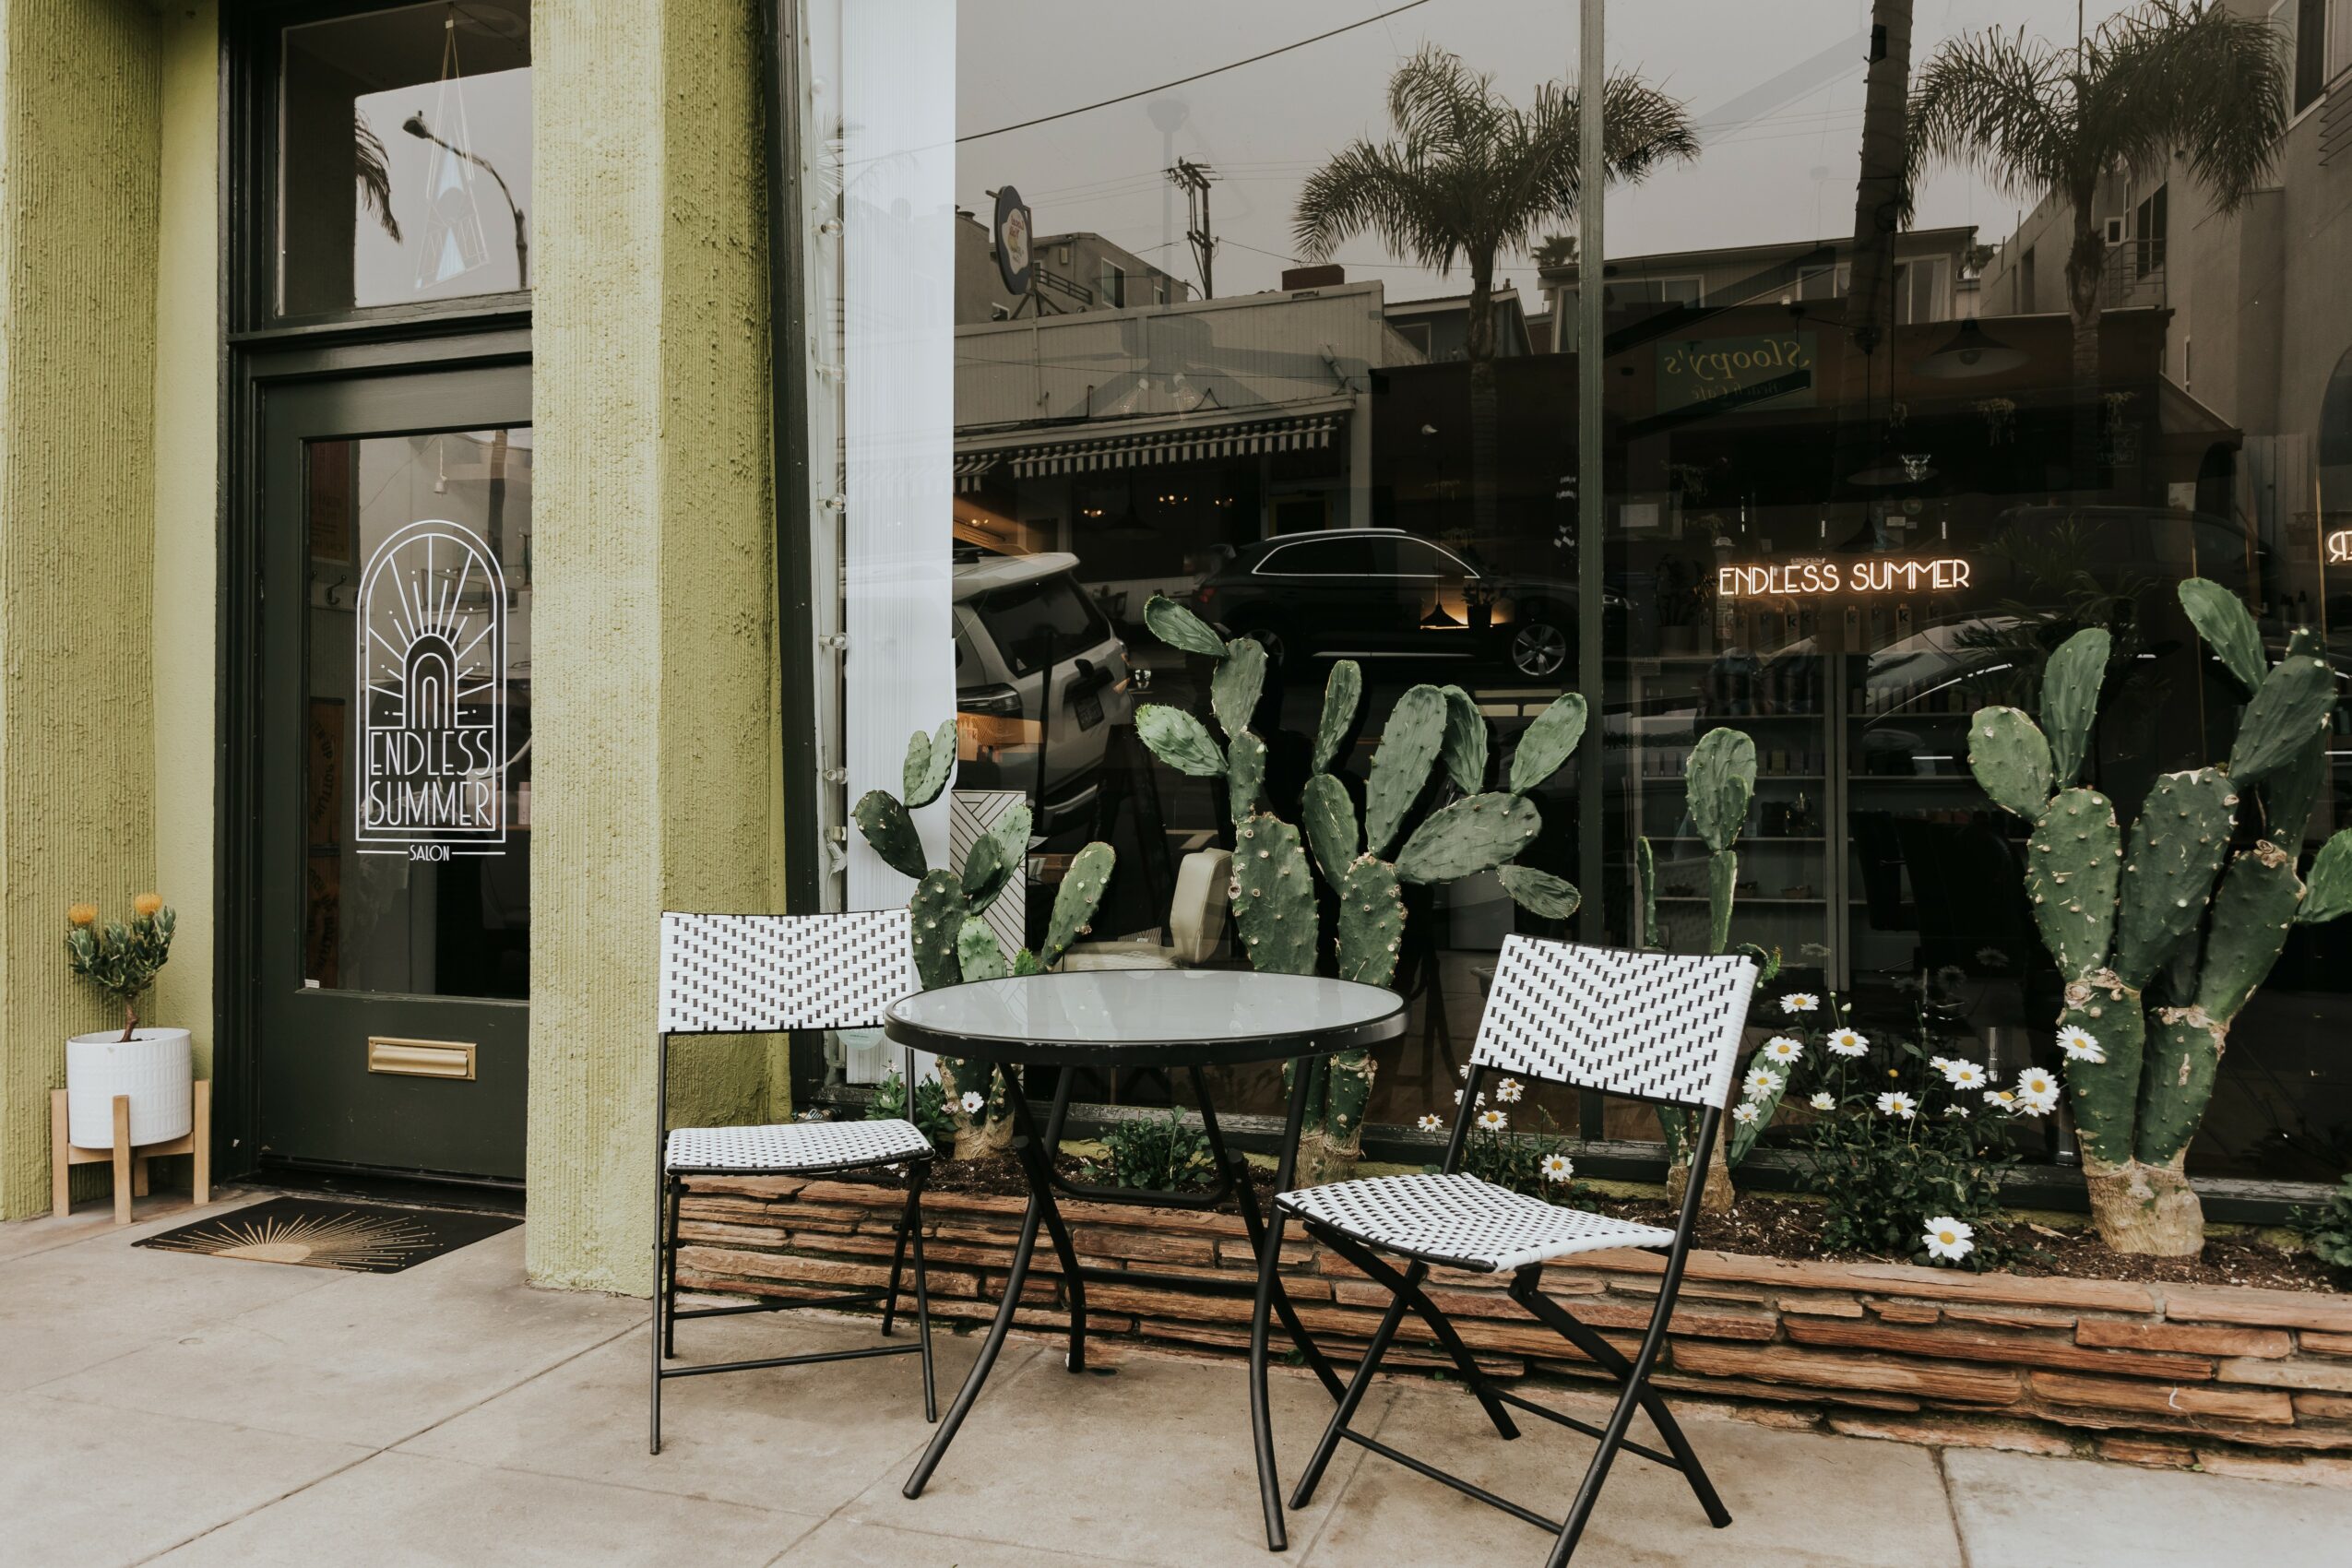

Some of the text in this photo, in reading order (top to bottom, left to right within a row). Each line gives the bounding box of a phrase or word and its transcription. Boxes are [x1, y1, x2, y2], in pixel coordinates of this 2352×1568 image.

[1719, 559, 1970, 595] ENDLESS SUMMER
[370, 731, 492, 776] ENDLESS
[369, 781, 492, 826] SUMMER
[410, 844, 450, 861] SALON
